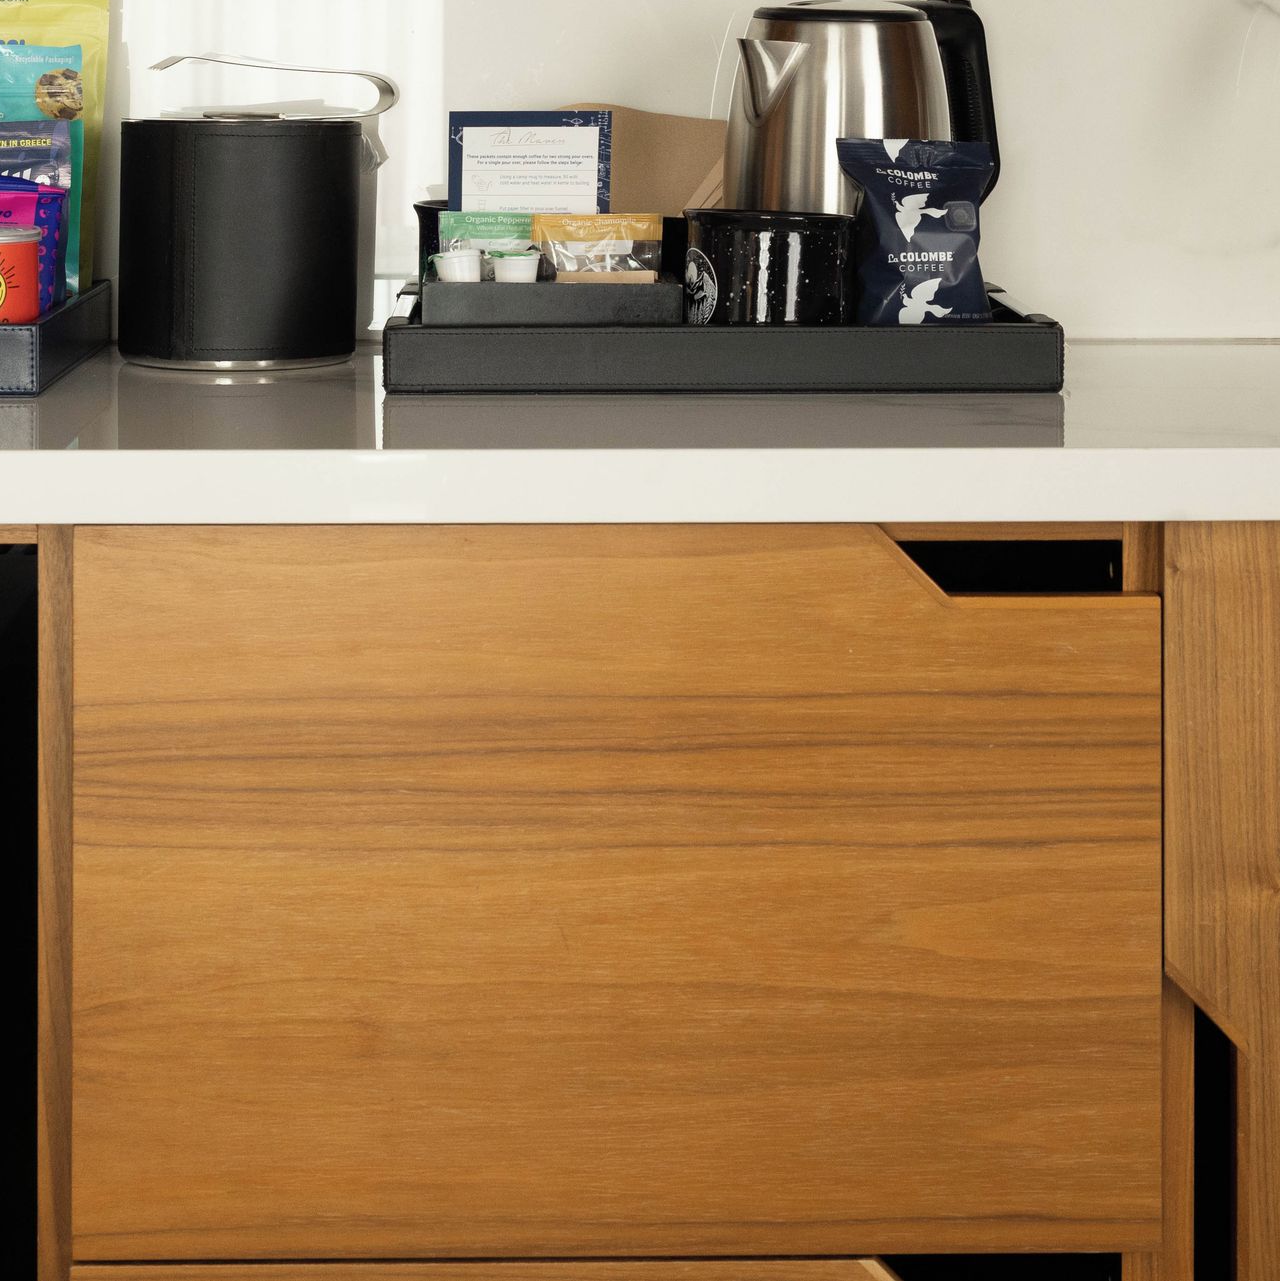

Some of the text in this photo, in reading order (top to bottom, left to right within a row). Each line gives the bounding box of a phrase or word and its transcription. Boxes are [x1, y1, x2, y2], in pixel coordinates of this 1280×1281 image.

[20, 139, 52, 147] GREECE
[887, 169, 939, 181] COLOMBE
[887, 176, 931, 189] COFFEE
[465, 215, 497, 224] Organic
[562, 219, 592, 227] Organic
[888, 251, 954, 263] La COLOMBE
[899, 264, 945, 272] COFFEE
